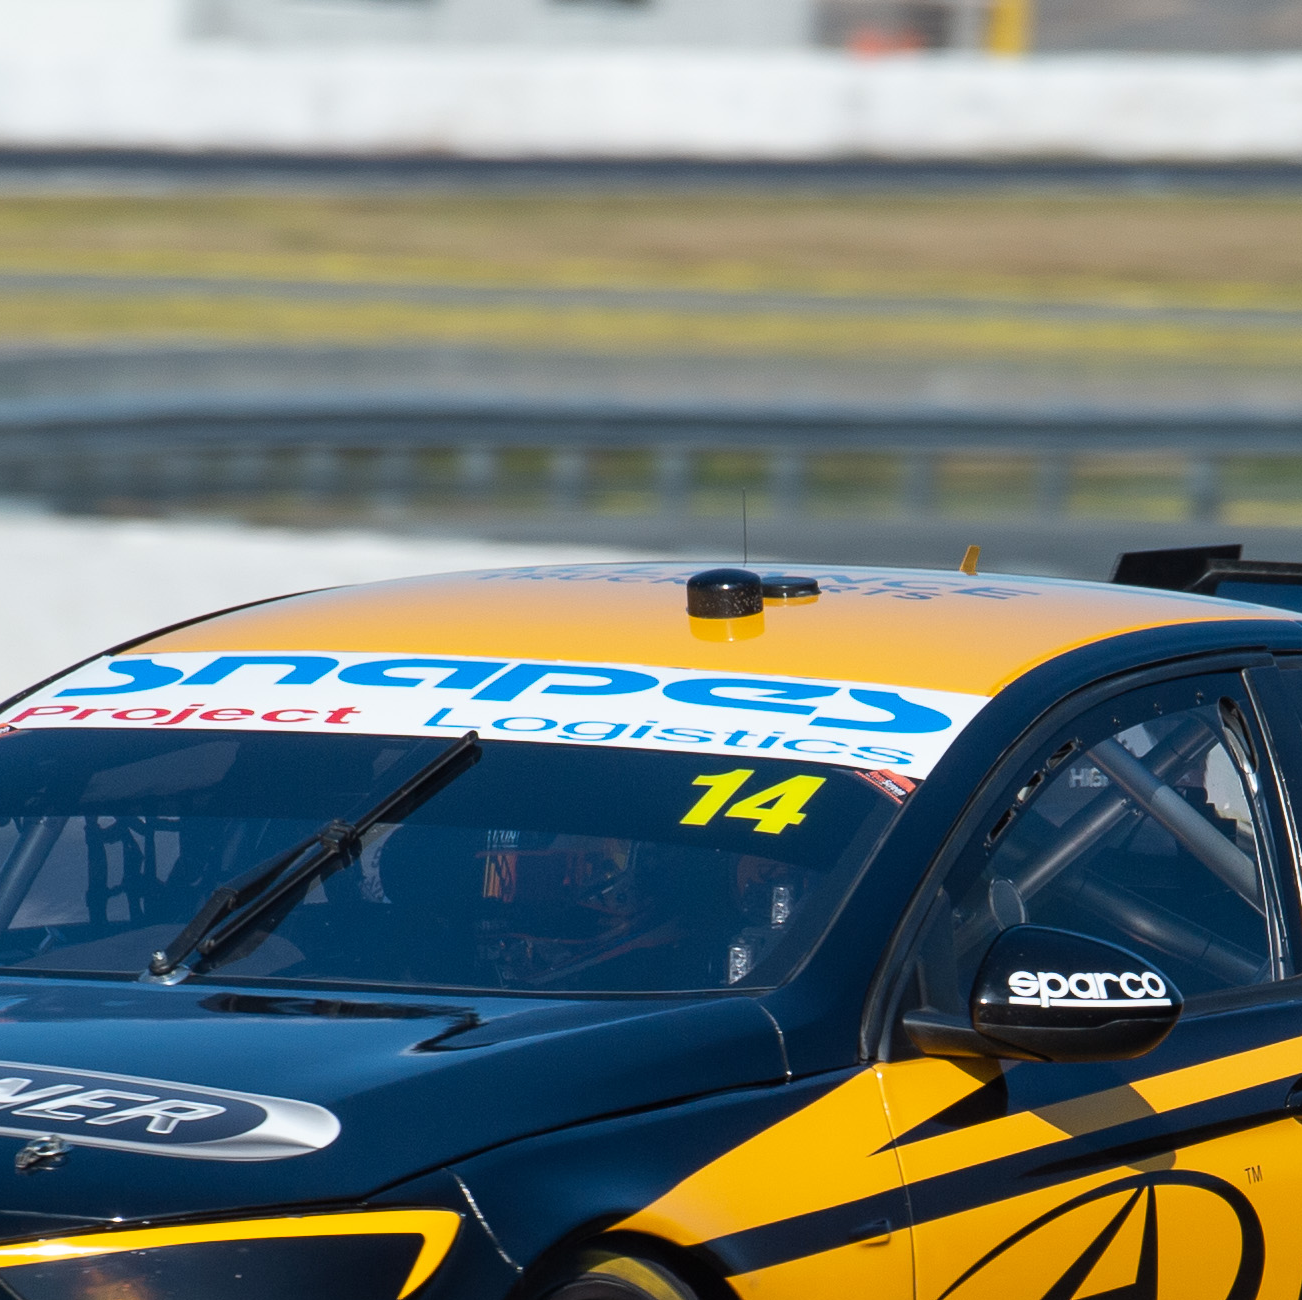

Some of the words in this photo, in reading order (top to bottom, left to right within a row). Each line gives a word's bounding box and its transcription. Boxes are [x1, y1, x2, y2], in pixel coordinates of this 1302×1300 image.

[54, 656, 952, 734] snapes
[8, 704, 362, 726] Project
[422, 707, 915, 765] Logistics
[679, 769, 826, 834] 14
[1008, 971, 1166, 1008] sparco
